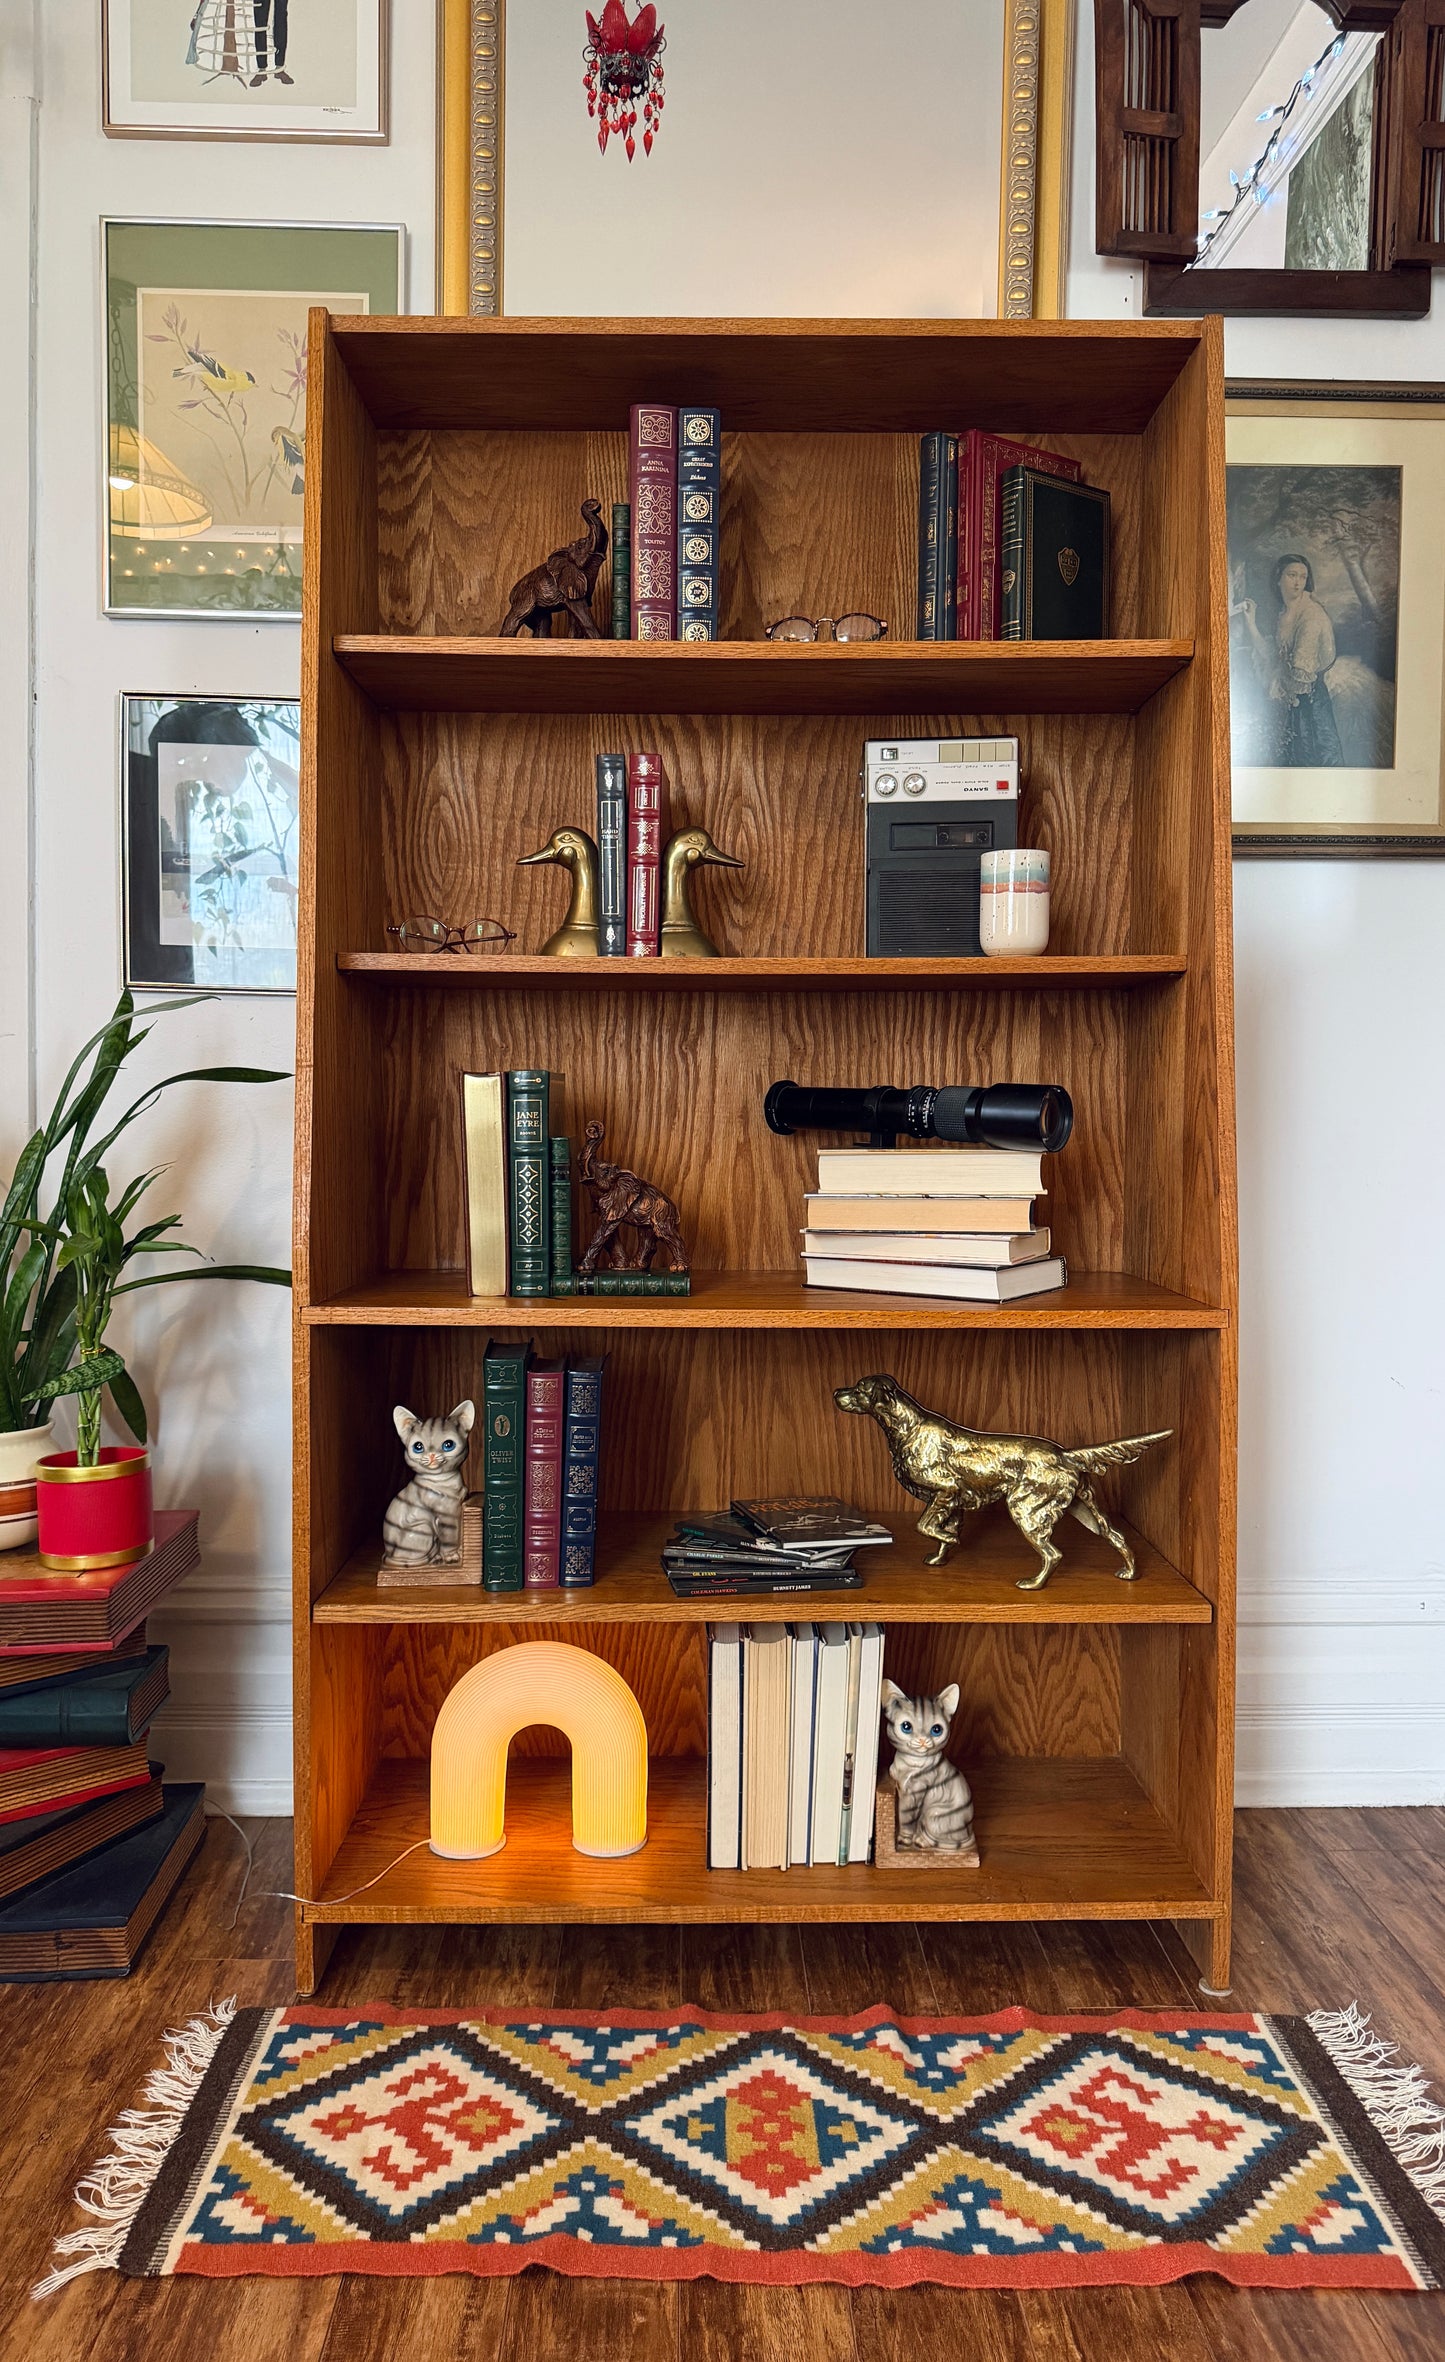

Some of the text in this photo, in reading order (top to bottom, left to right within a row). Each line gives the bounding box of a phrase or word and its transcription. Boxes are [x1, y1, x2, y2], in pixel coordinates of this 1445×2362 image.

[641, 465, 670, 473] KARENINA
[516, 1111, 539, 1120] JANE
[516, 1120, 540, 1128] EYRE
